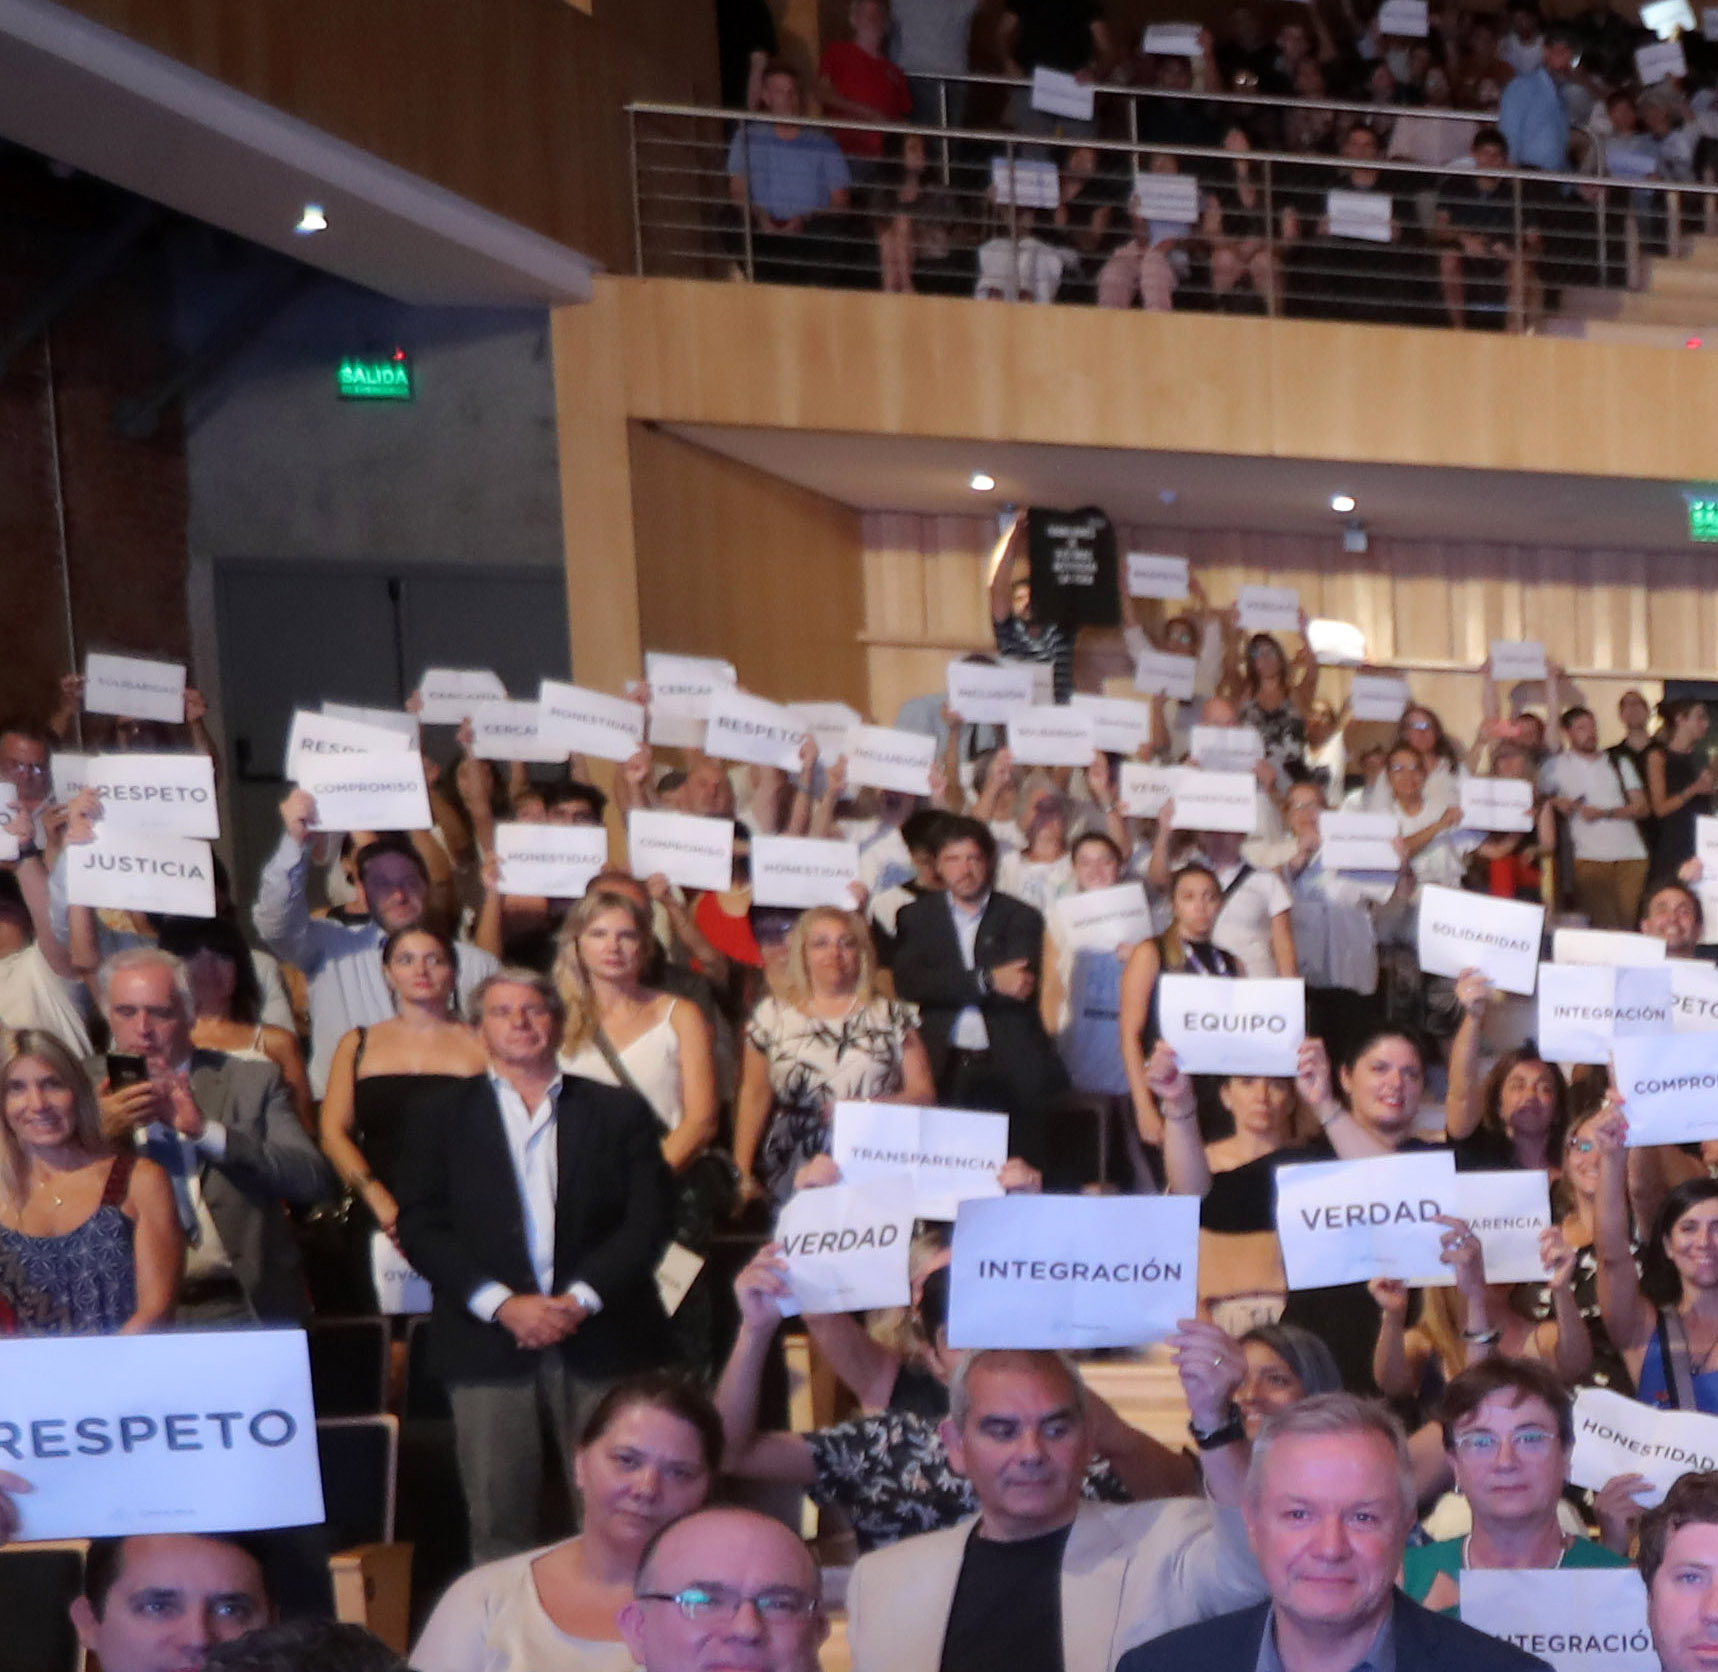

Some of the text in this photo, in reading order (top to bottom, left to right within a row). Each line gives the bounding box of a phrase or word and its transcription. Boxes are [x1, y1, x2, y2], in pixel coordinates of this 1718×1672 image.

[342, 366, 408, 384] SALIDA
[659, 684, 712, 697] CERCA
[484, 723, 538, 736] CERCA
[550, 705, 639, 735] HONESTIDAD
[718, 716, 803, 744] RESPETO
[96, 785, 208, 803] RESPETO
[313, 781, 418, 794] COMPROMISO
[1129, 782, 1169, 793] VERD
[508, 851, 601, 864] HONESTIDAD
[640, 837, 726, 858] COMPROMISO
[83, 852, 206, 881] JUSTICIA
[764, 863, 855, 878] HONESTIDAD
[1431, 921, 1531, 953] SOLIDARIDAD
[1183, 1011, 1288, 1034] EQUIPO
[1553, 1004, 1667, 1022] INTEGRACIÓN
[850, 1146, 996, 1171] TRANSPARENCIA
[1301, 1199, 1441, 1231] VERDAD
[783, 1223, 899, 1257] VERDAD
[979, 1256, 1181, 1283] INTEGRACIÓN
[0, 1408, 297, 1460] RESPETO
[1582, 1417, 1715, 1471] HONESTIDAD
